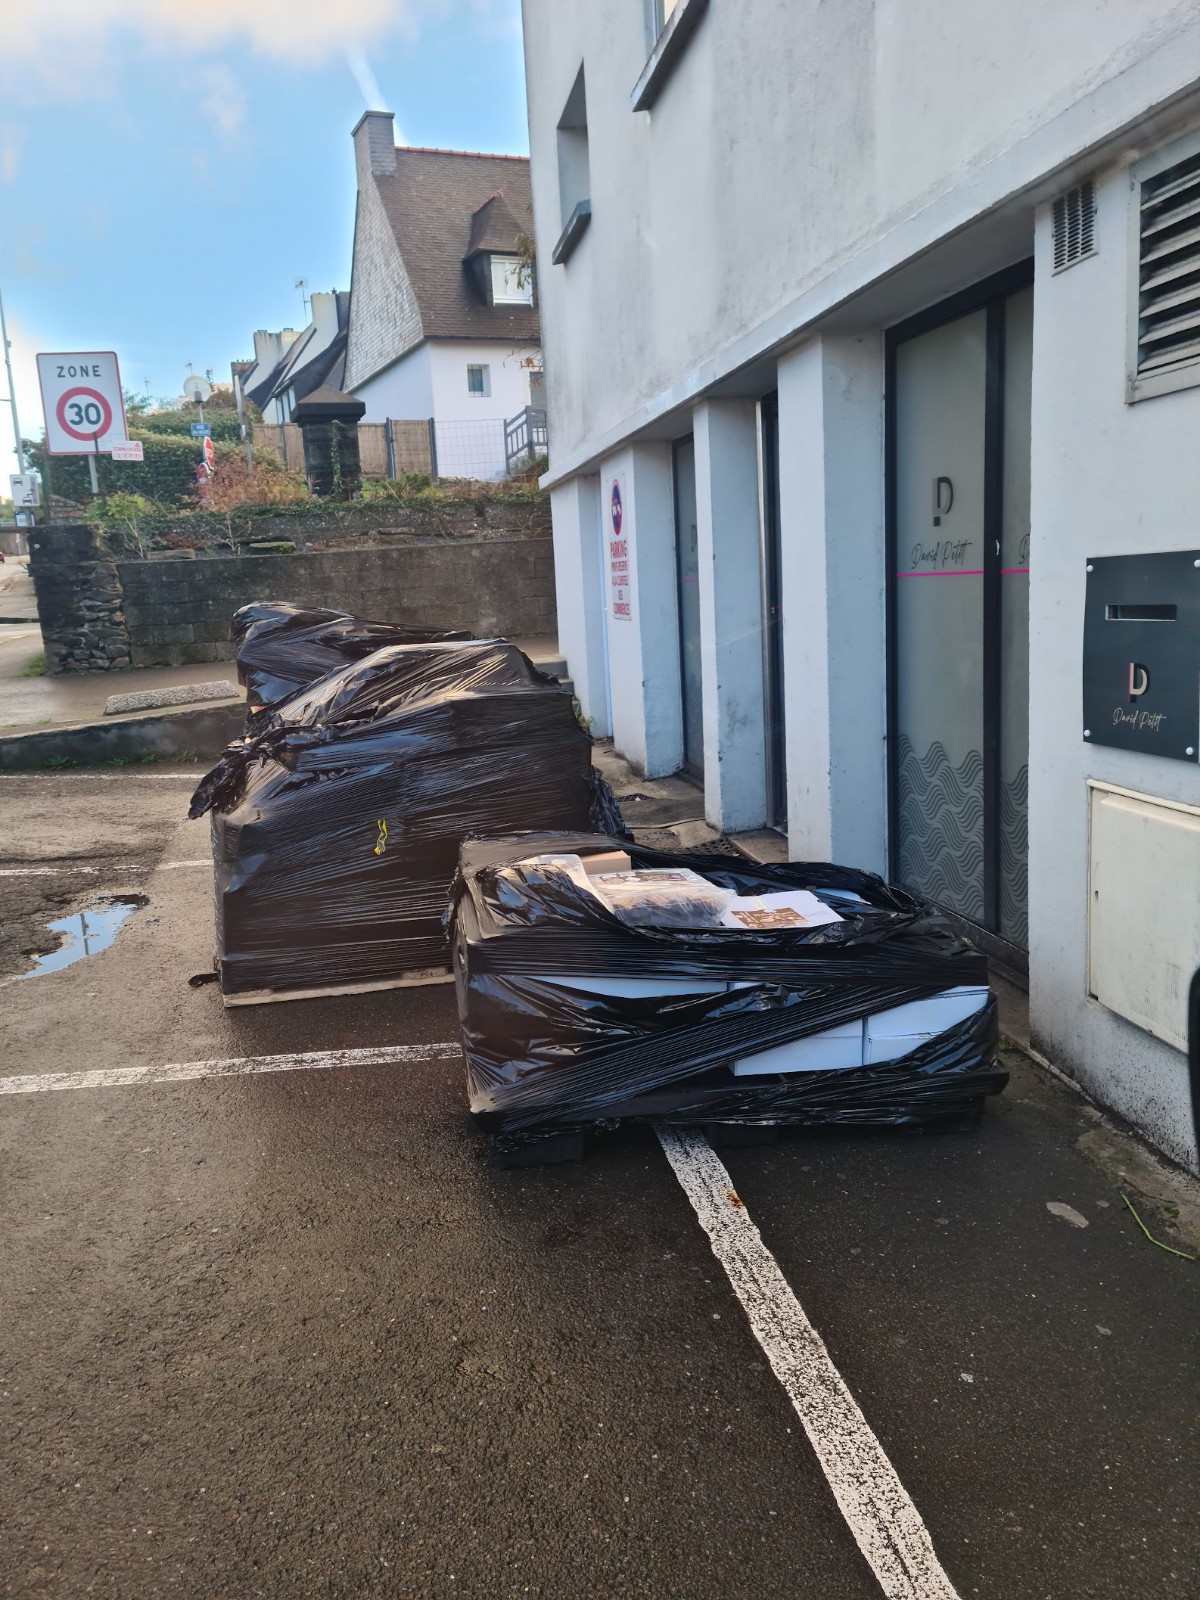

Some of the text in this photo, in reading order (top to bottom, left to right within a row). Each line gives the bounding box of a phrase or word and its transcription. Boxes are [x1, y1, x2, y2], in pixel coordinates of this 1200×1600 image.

[56, 365, 102, 378] ZONE
[68, 403, 101, 426] 30
[911, 542, 940, 570] David
[1113, 707, 1167, 732] David Petit
